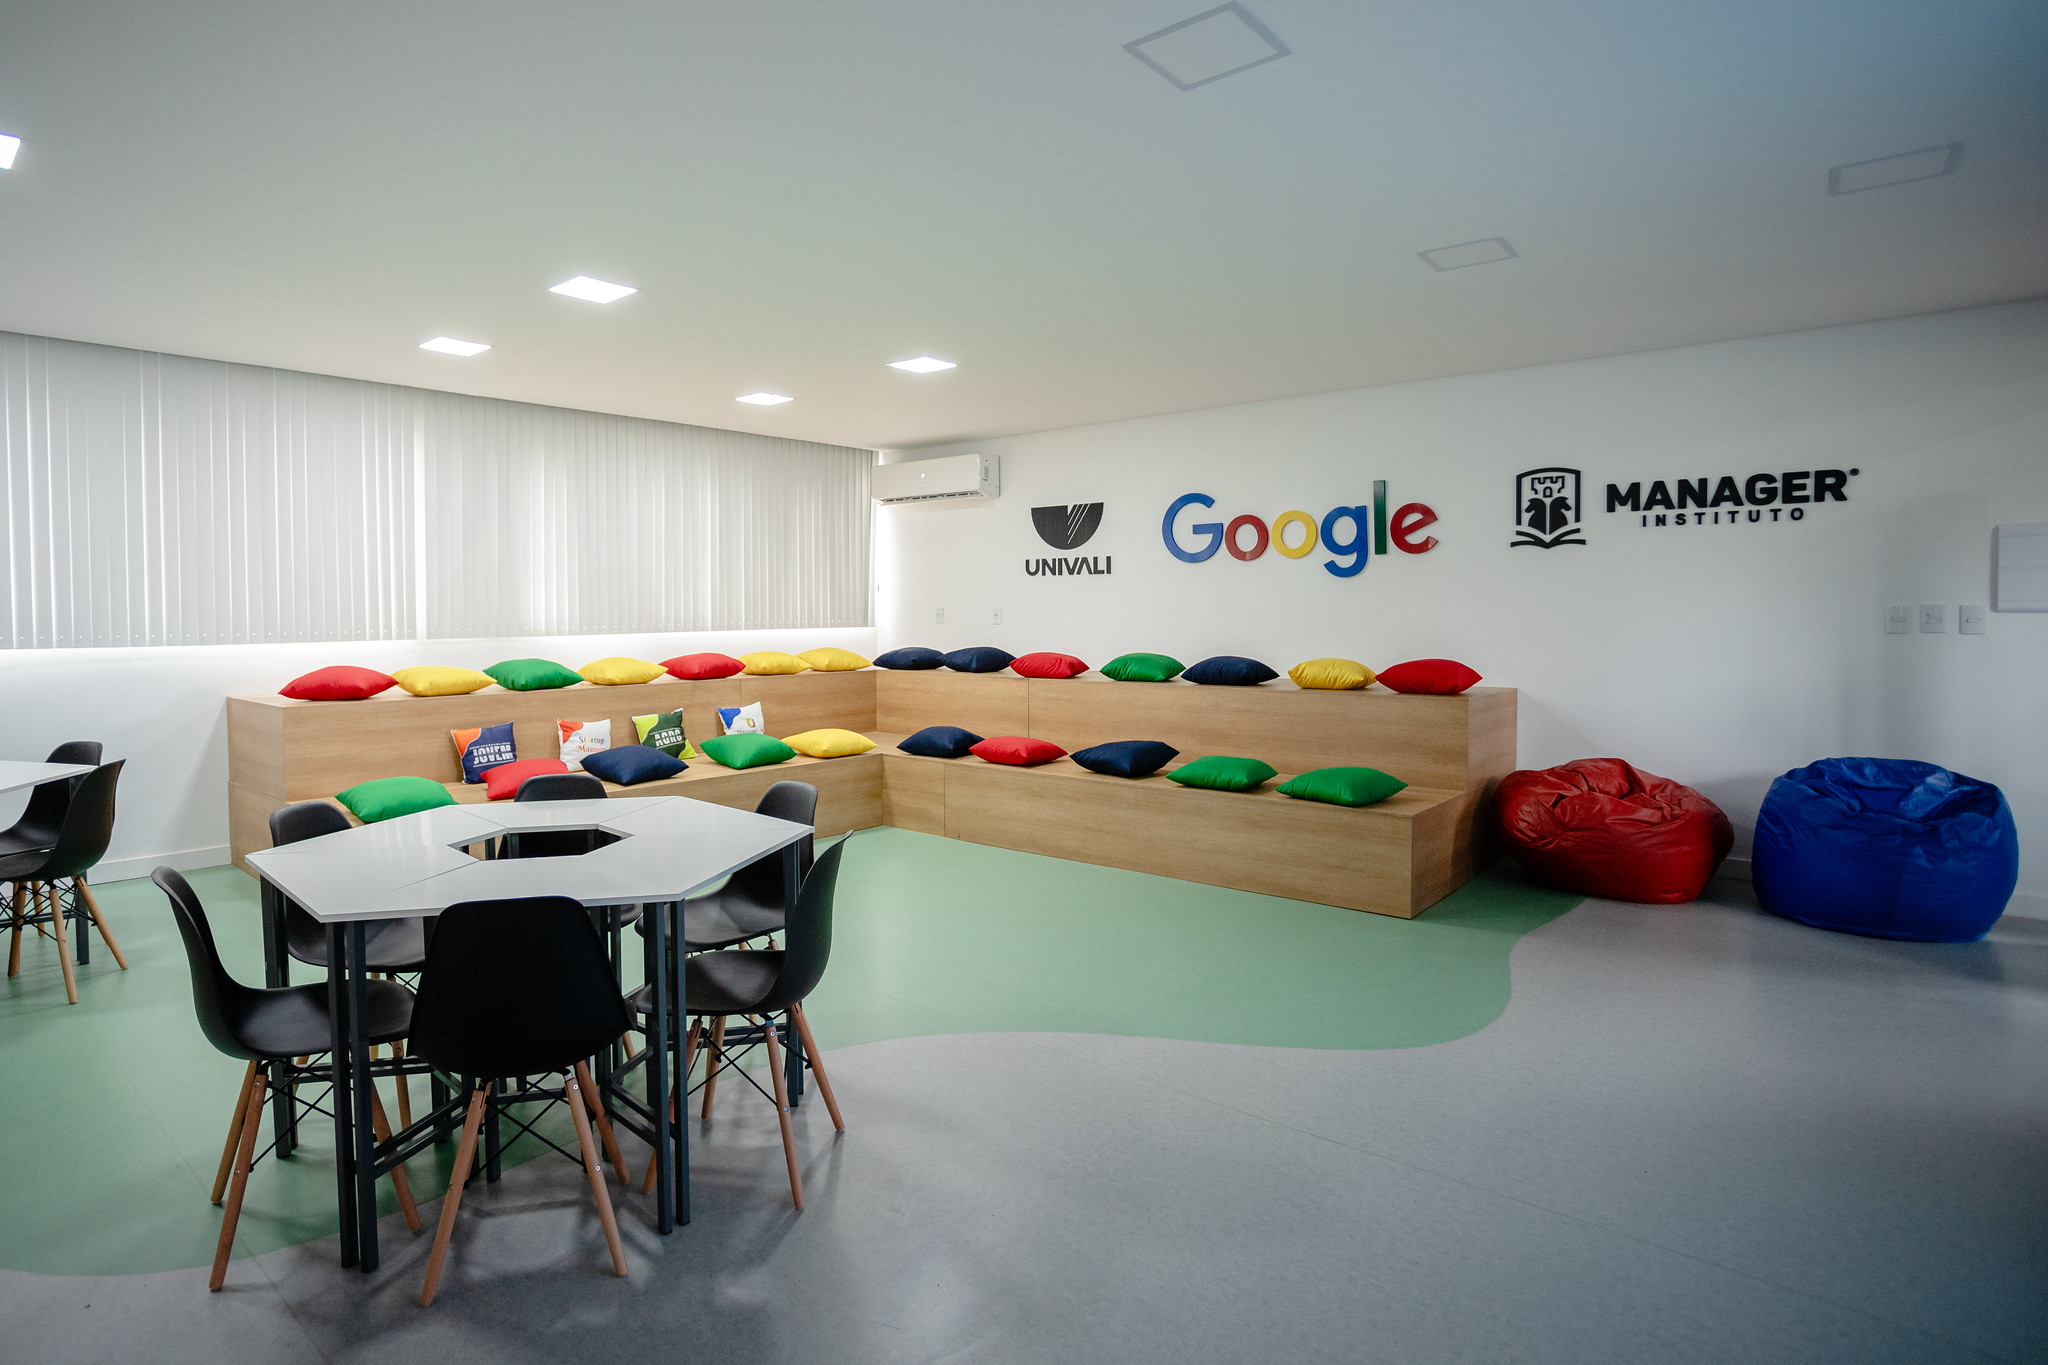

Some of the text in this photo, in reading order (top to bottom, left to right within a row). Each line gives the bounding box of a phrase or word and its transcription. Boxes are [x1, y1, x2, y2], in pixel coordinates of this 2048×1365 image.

[1642, 507, 1805, 528] INSTITUTO
[1162, 479, 1440, 578] Google
[1025, 556, 1112, 577] UNIVALI
[578, 736, 605, 746] Startup
